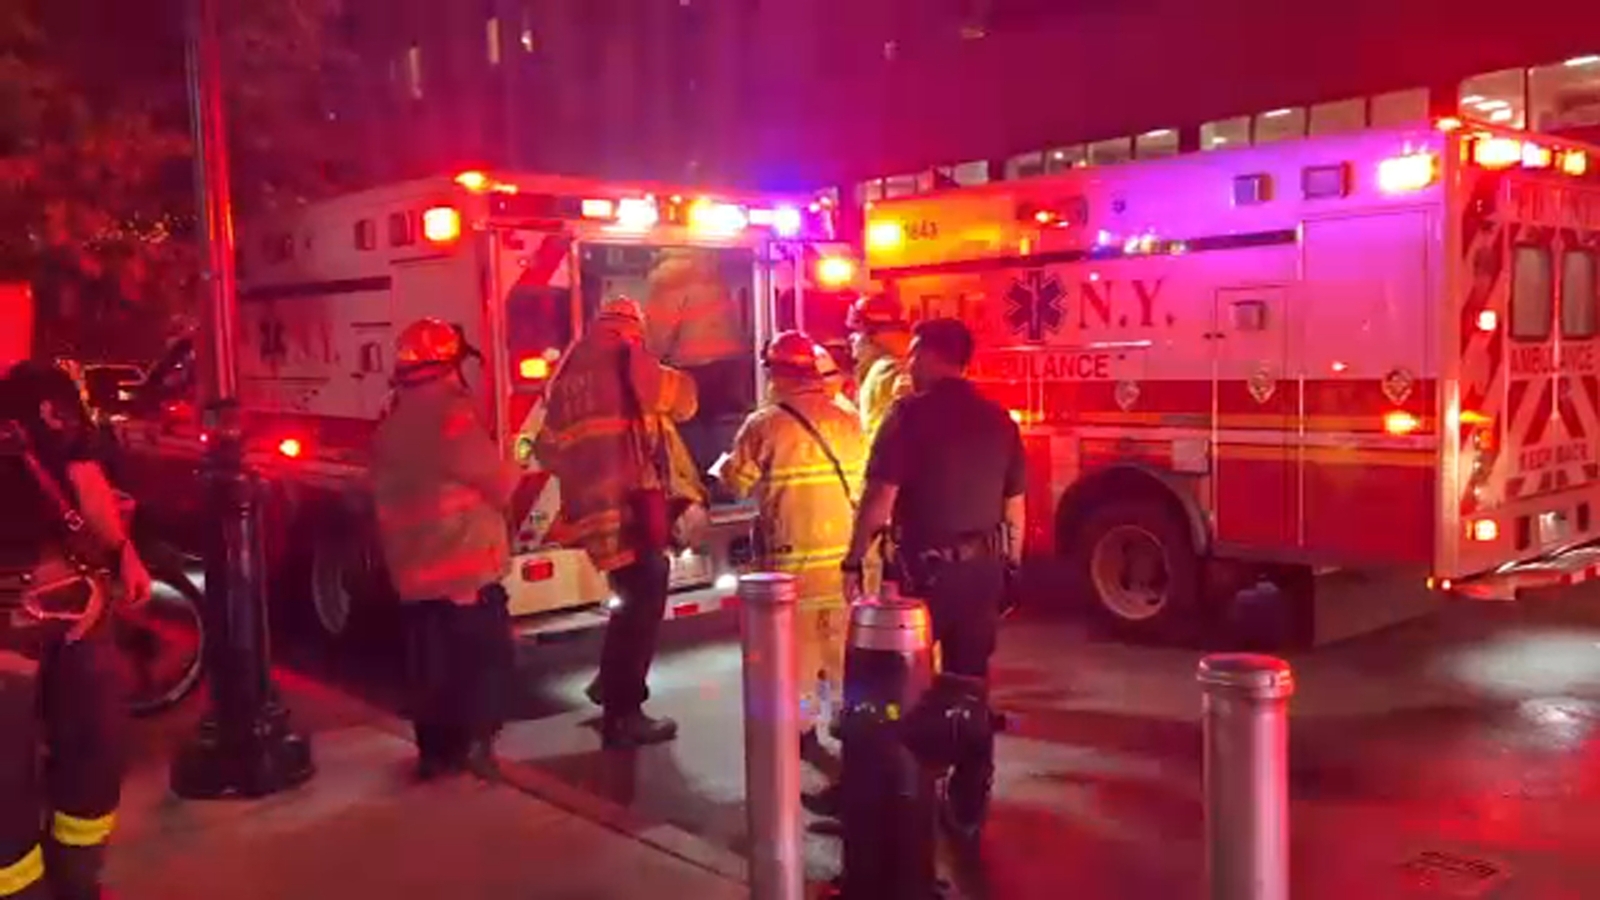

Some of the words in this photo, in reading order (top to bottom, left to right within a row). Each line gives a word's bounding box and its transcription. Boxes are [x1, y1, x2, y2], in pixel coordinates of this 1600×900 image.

[1079, 280, 1175, 329] N.Y.
[966, 354, 1109, 381] BULANCE
[1510, 345, 1594, 373] AMBULANCE
